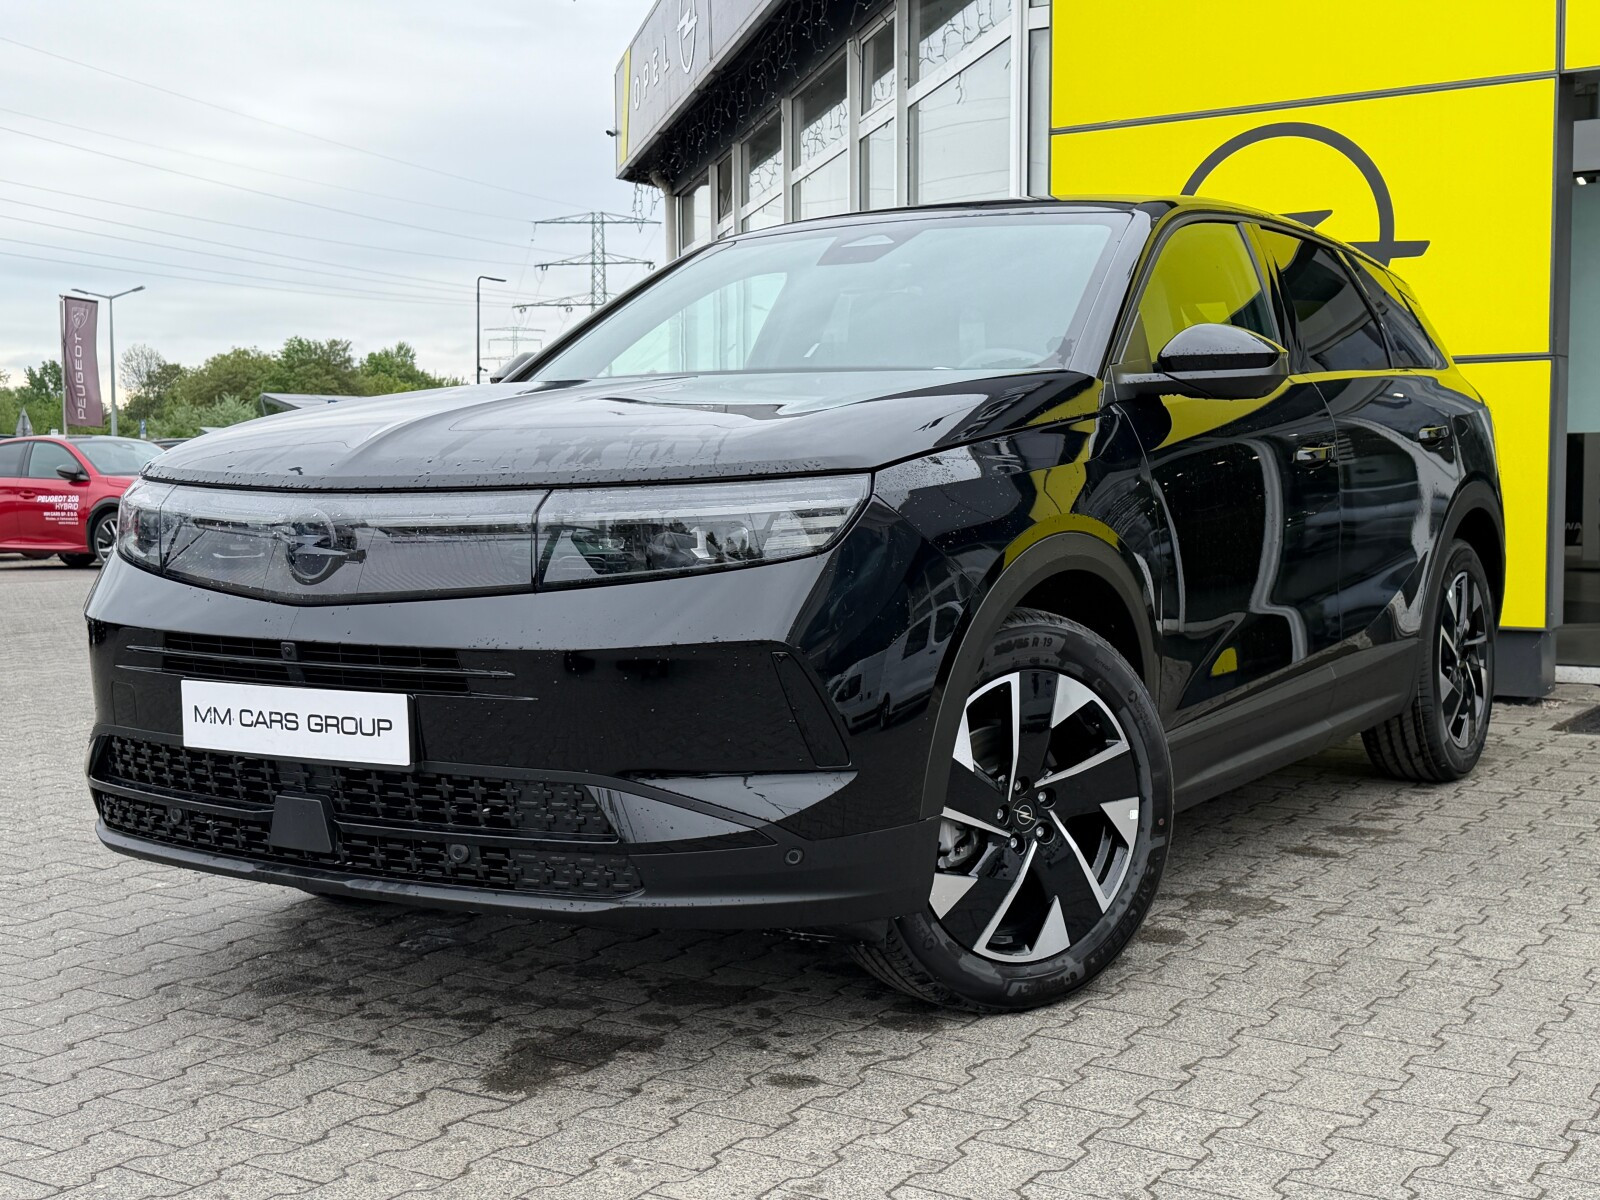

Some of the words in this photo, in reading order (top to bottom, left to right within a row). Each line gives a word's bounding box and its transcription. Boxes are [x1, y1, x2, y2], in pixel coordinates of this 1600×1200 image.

[633, 35, 671, 111] OPEL
[74, 332, 87, 420] PEUGEOT
[1043, 637, 1053, 648] 19
[193, 704, 232, 726] MM
[239, 708, 299, 731] CARS
[307, 713, 393, 737] GROUP
